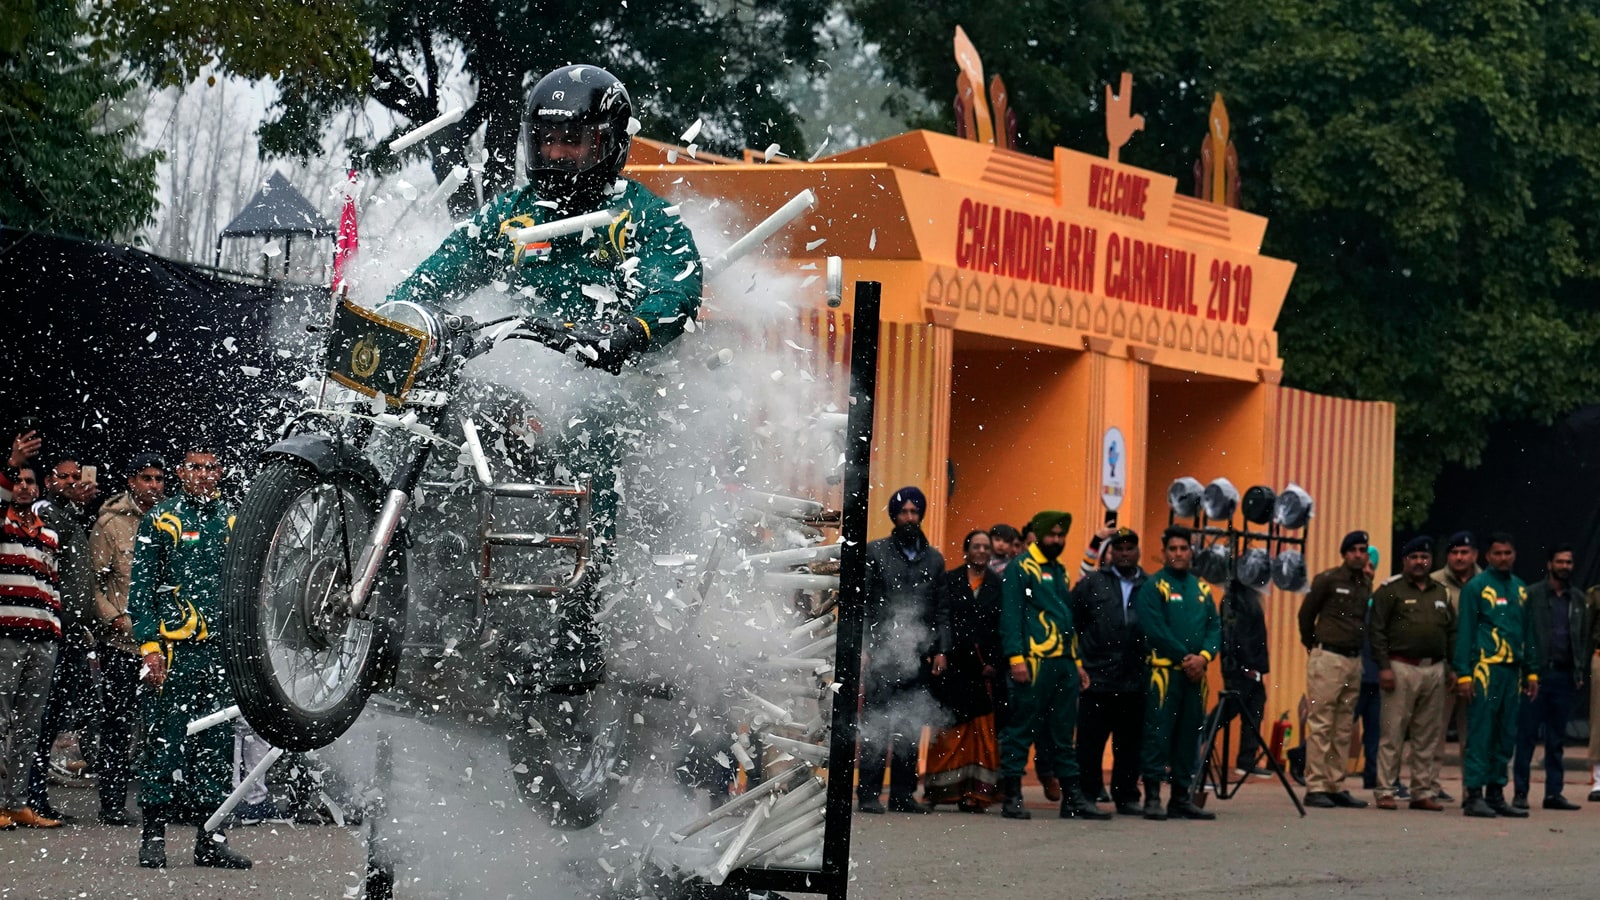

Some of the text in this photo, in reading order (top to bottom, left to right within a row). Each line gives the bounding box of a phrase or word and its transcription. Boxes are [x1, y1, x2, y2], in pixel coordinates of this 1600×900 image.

[1087, 164, 1150, 220] WELCOME
[956, 198, 1253, 326] CHANDIGARH CARNIVAL 2019
